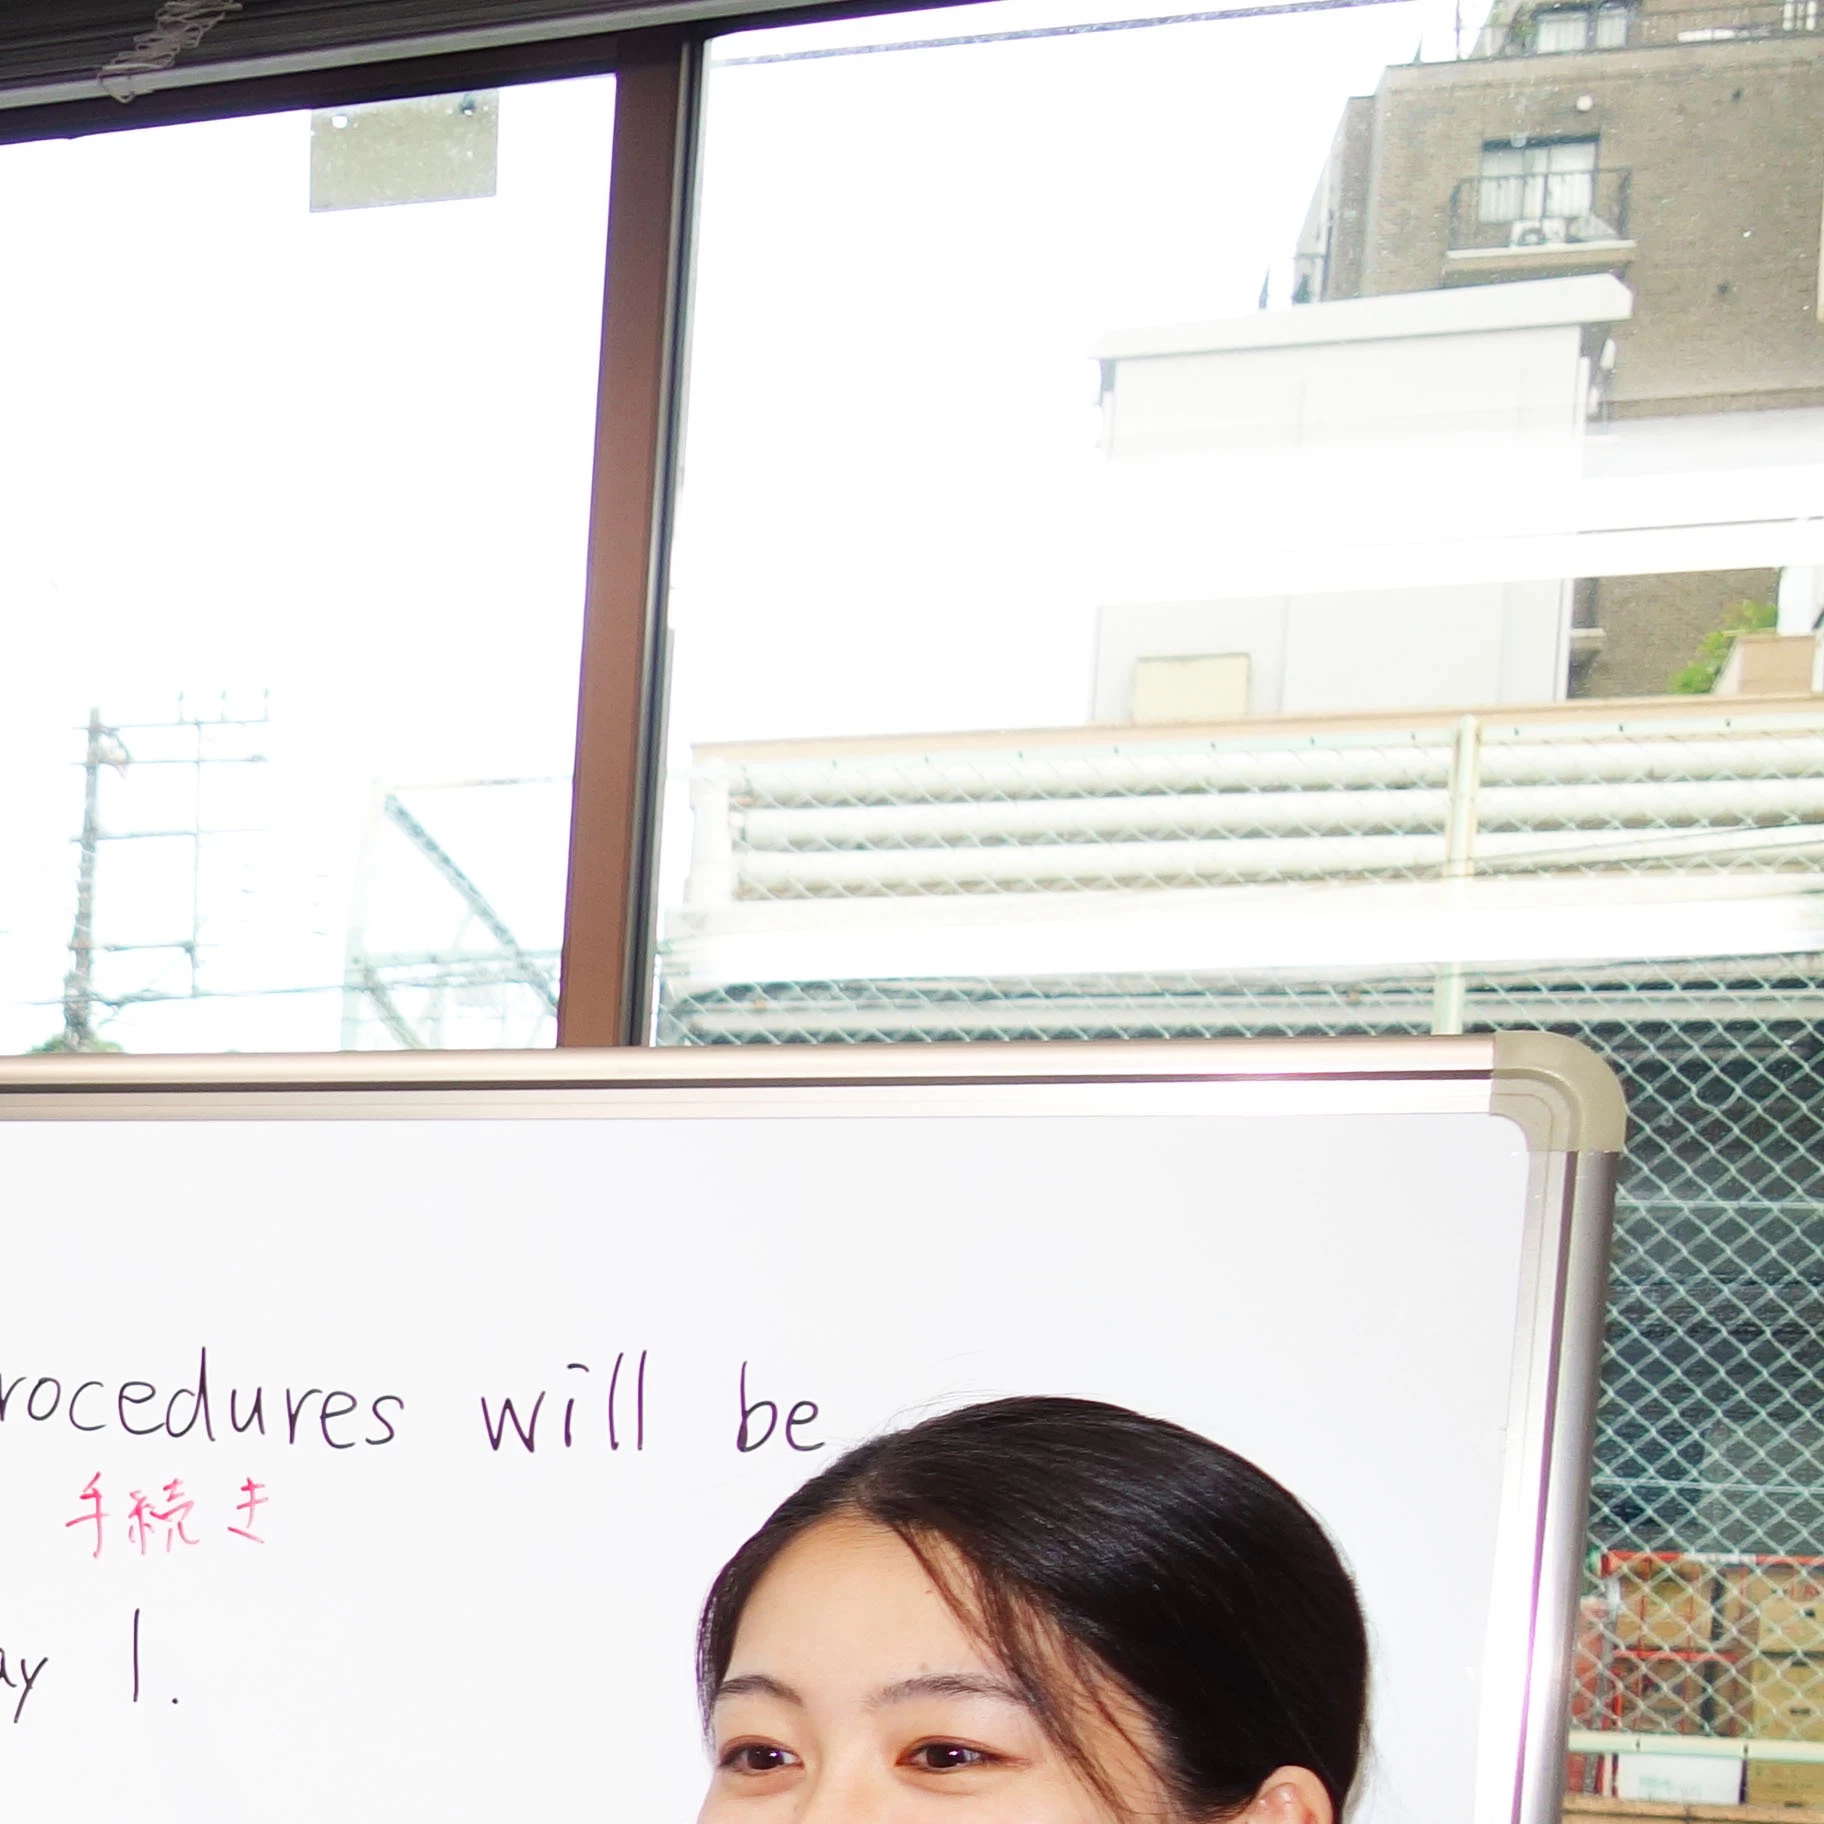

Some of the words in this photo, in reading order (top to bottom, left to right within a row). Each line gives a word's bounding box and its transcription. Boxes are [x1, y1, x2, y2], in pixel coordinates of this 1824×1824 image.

[480, 1349, 648, 1454] will
[735, 1360, 826, 1454] be
[64, 1471, 269, 1559] 手続き
